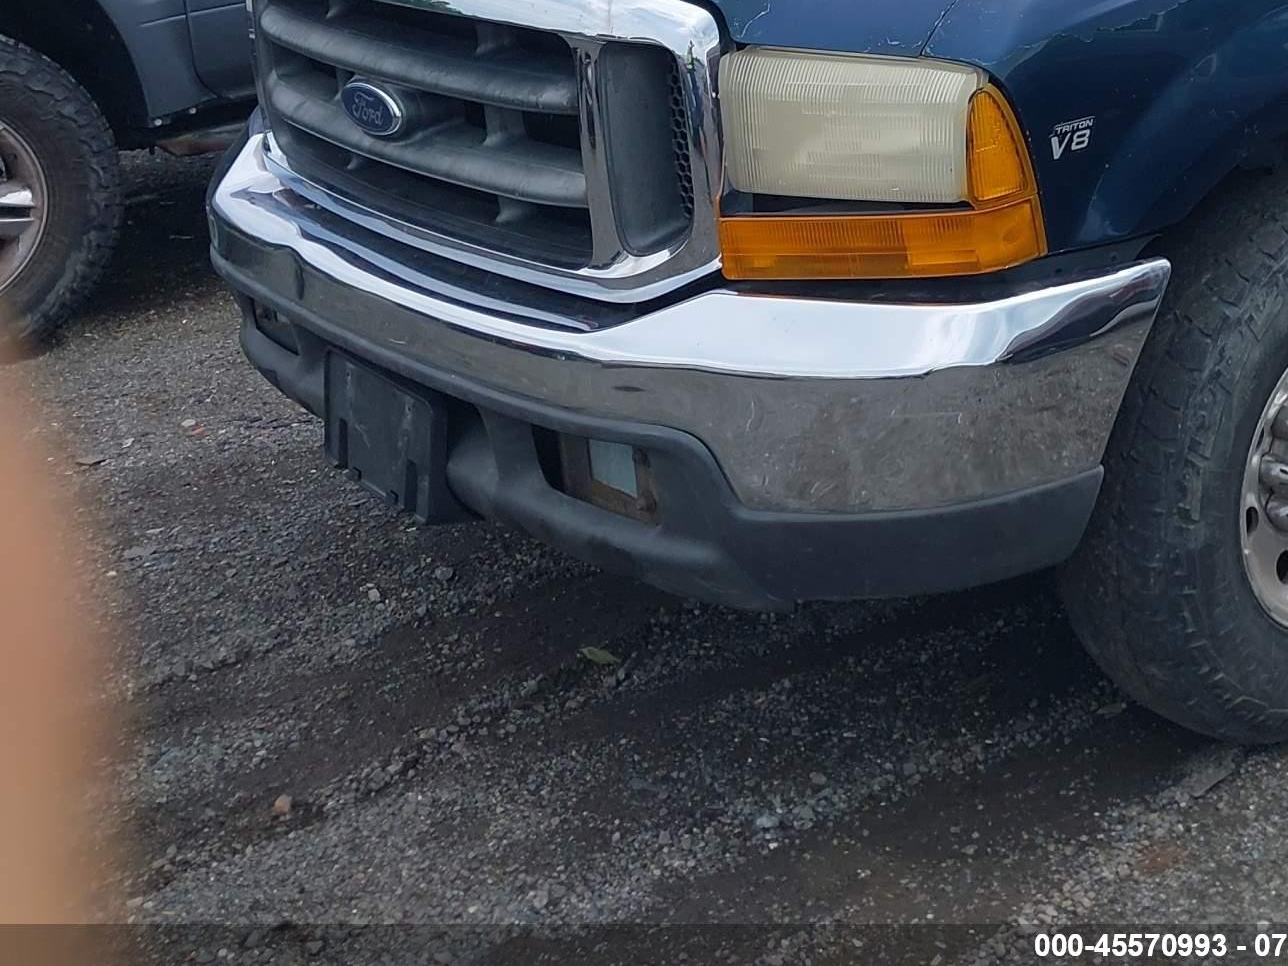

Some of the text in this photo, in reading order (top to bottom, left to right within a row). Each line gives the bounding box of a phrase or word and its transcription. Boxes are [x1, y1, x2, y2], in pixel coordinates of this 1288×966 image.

[352, 91, 384, 125] Ford
[1055, 118, 1094, 134] TRITON
[1051, 129, 1090, 160] V8
